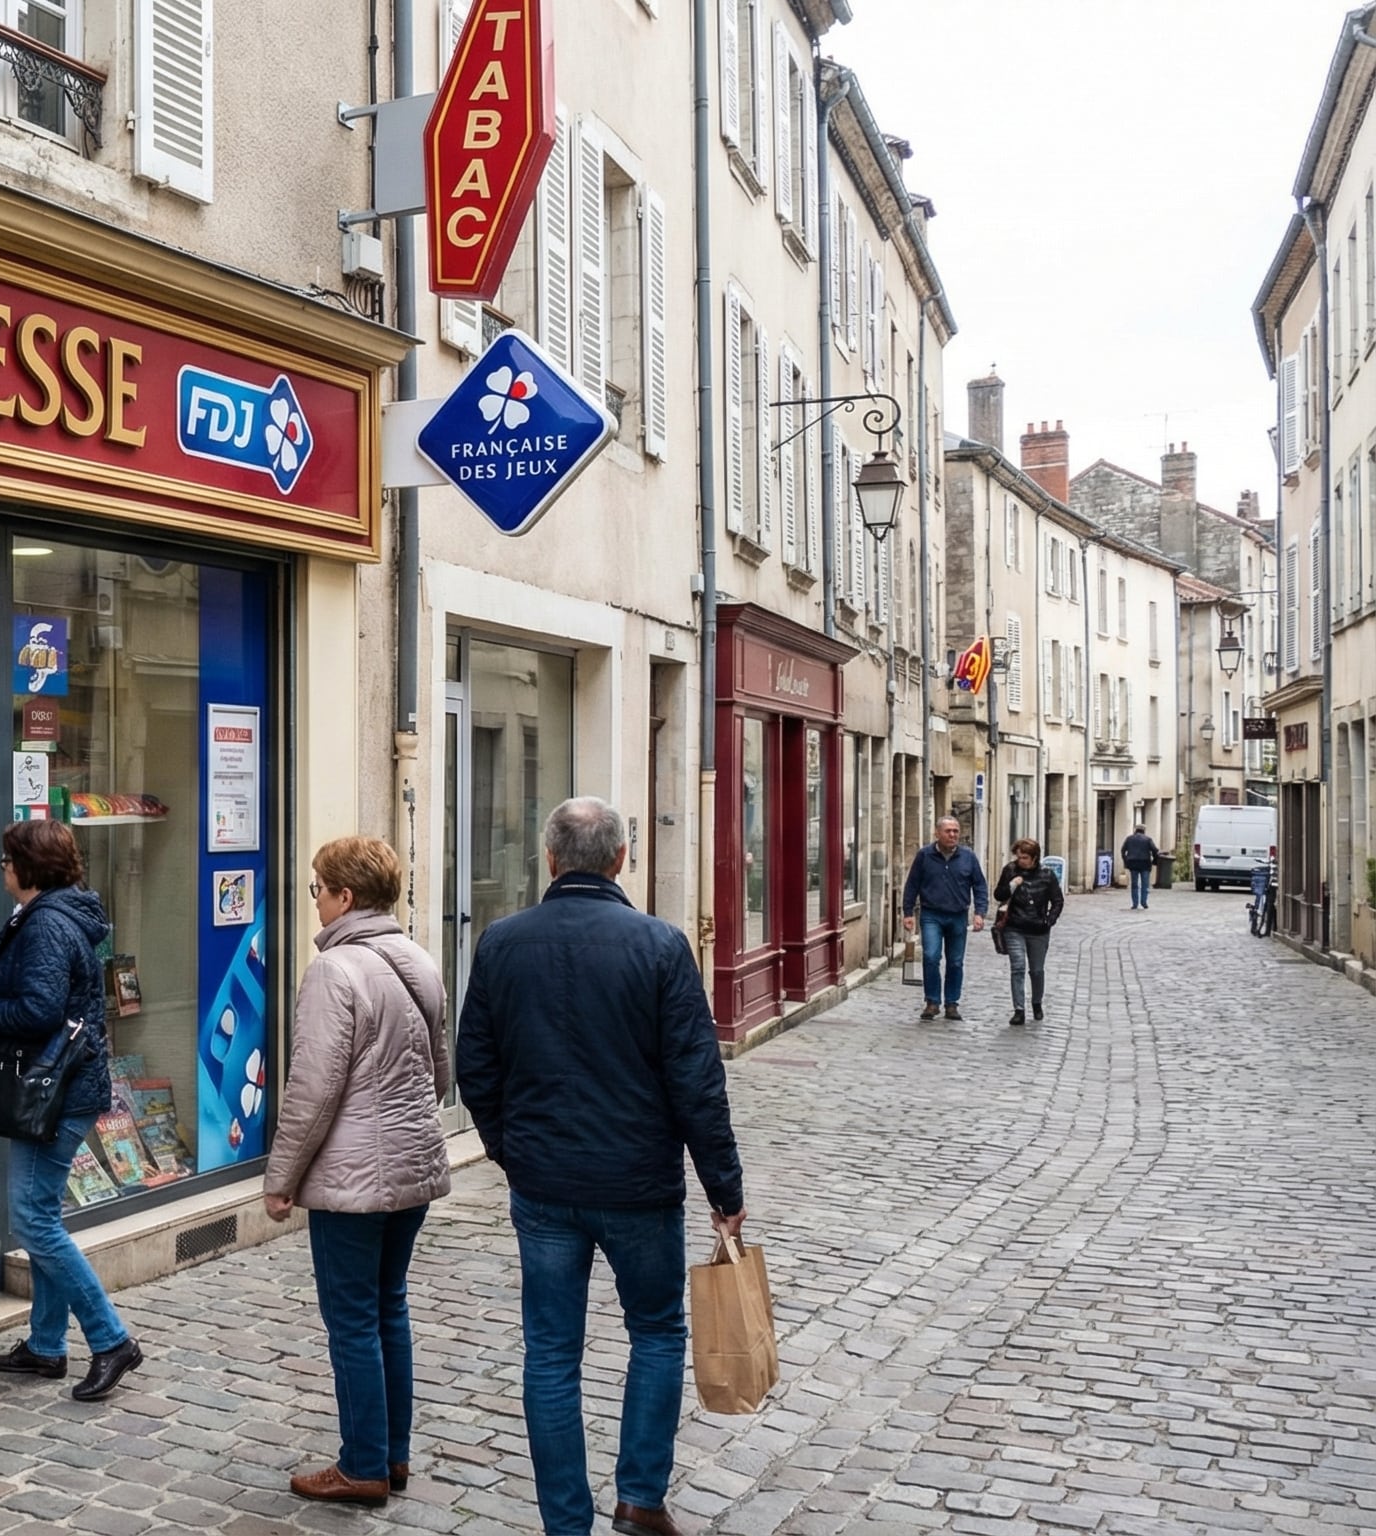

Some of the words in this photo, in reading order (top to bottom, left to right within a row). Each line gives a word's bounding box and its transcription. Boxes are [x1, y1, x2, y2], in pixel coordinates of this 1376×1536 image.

[446, 11, 522, 249] TABAC
[186, 385, 255, 450] FDJ
[451, 434, 568, 458] FRANÇAISE
[460, 463, 497, 480] DES
[506, 459, 557, 480] JEUX
